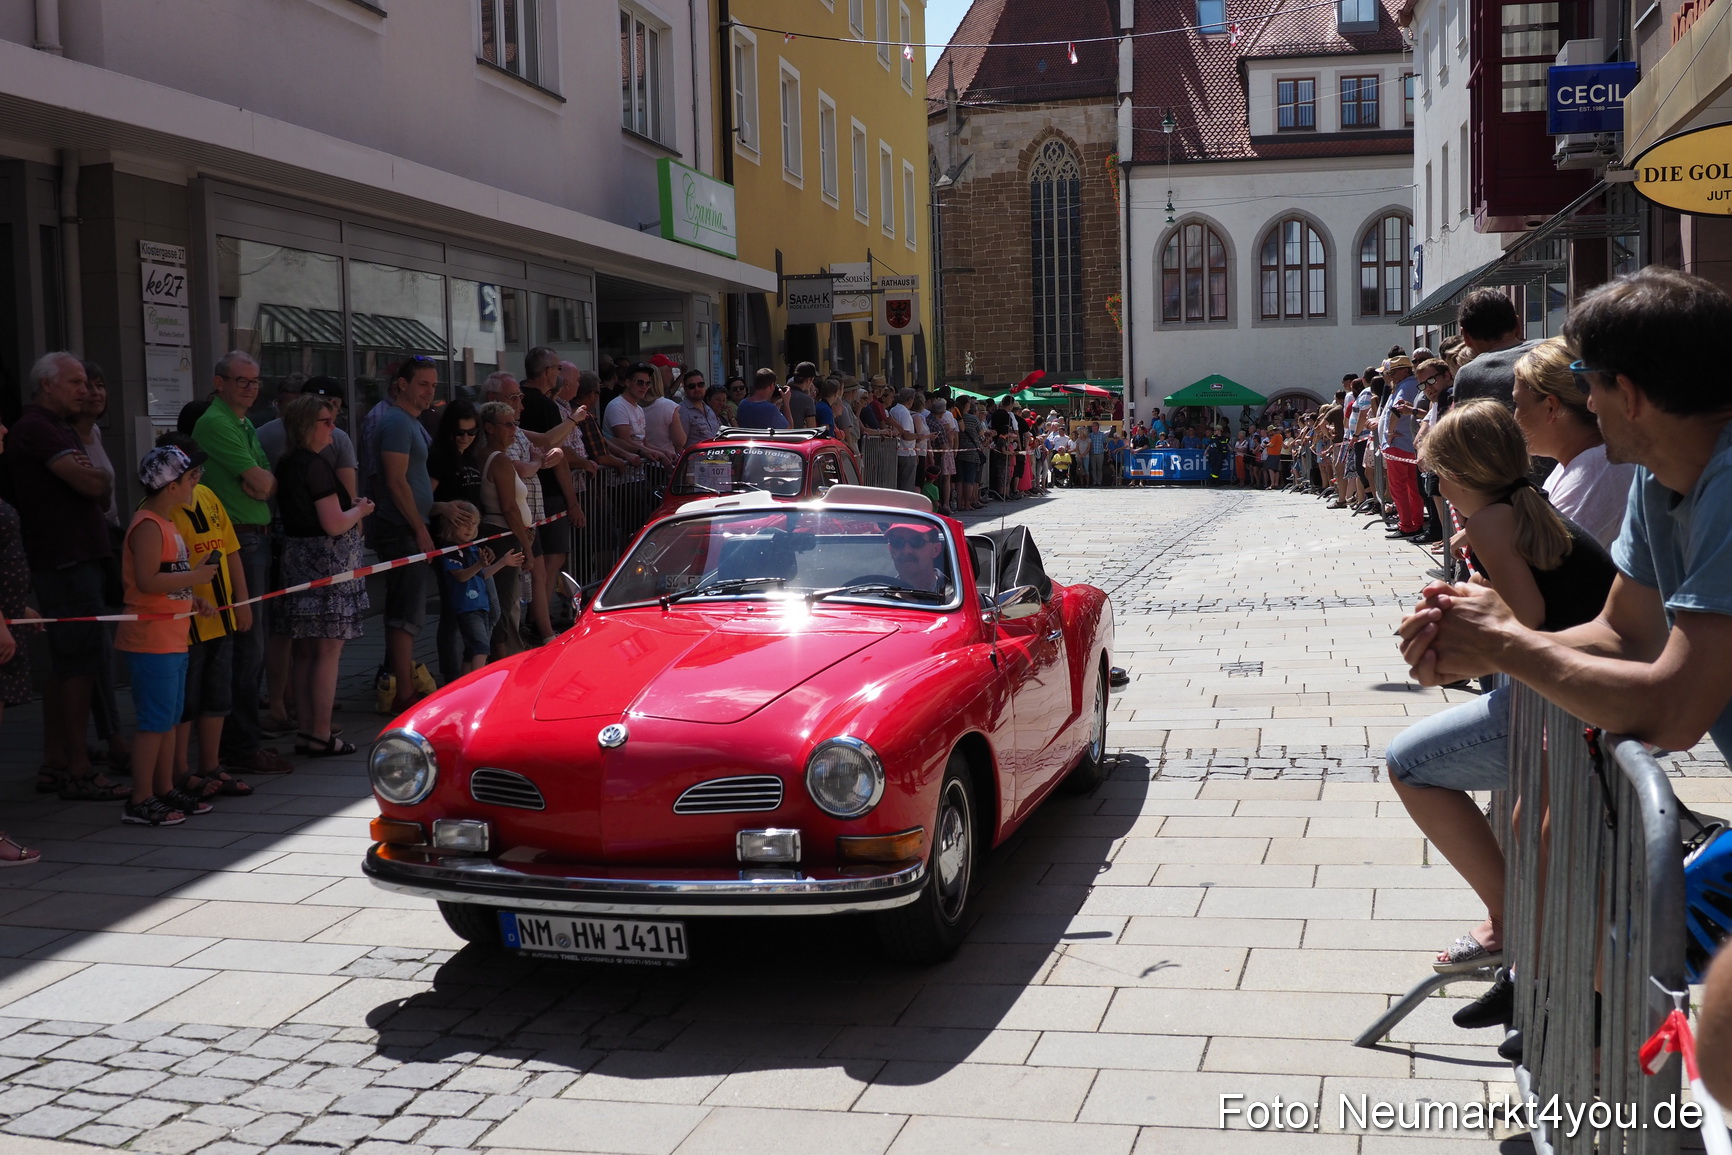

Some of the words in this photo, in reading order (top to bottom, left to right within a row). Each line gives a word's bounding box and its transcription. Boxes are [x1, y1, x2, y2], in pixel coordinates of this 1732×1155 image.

[1557, 84, 1624, 105] CECIL
[1644, 166, 1683, 183] DIE
[1707, 190, 1732, 201] JUT
[141, 243, 177, 260] Klostergasse
[178, 249, 184, 260] 27
[146, 270, 185, 298] ke27
[881, 279, 910, 287] RATHAUS
[822, 292, 830, 304] K
[508, 933, 516, 942] D
[518, 918, 553, 947] NM
[571, 921, 605, 950] HW
[613, 924, 684, 954] 141H
